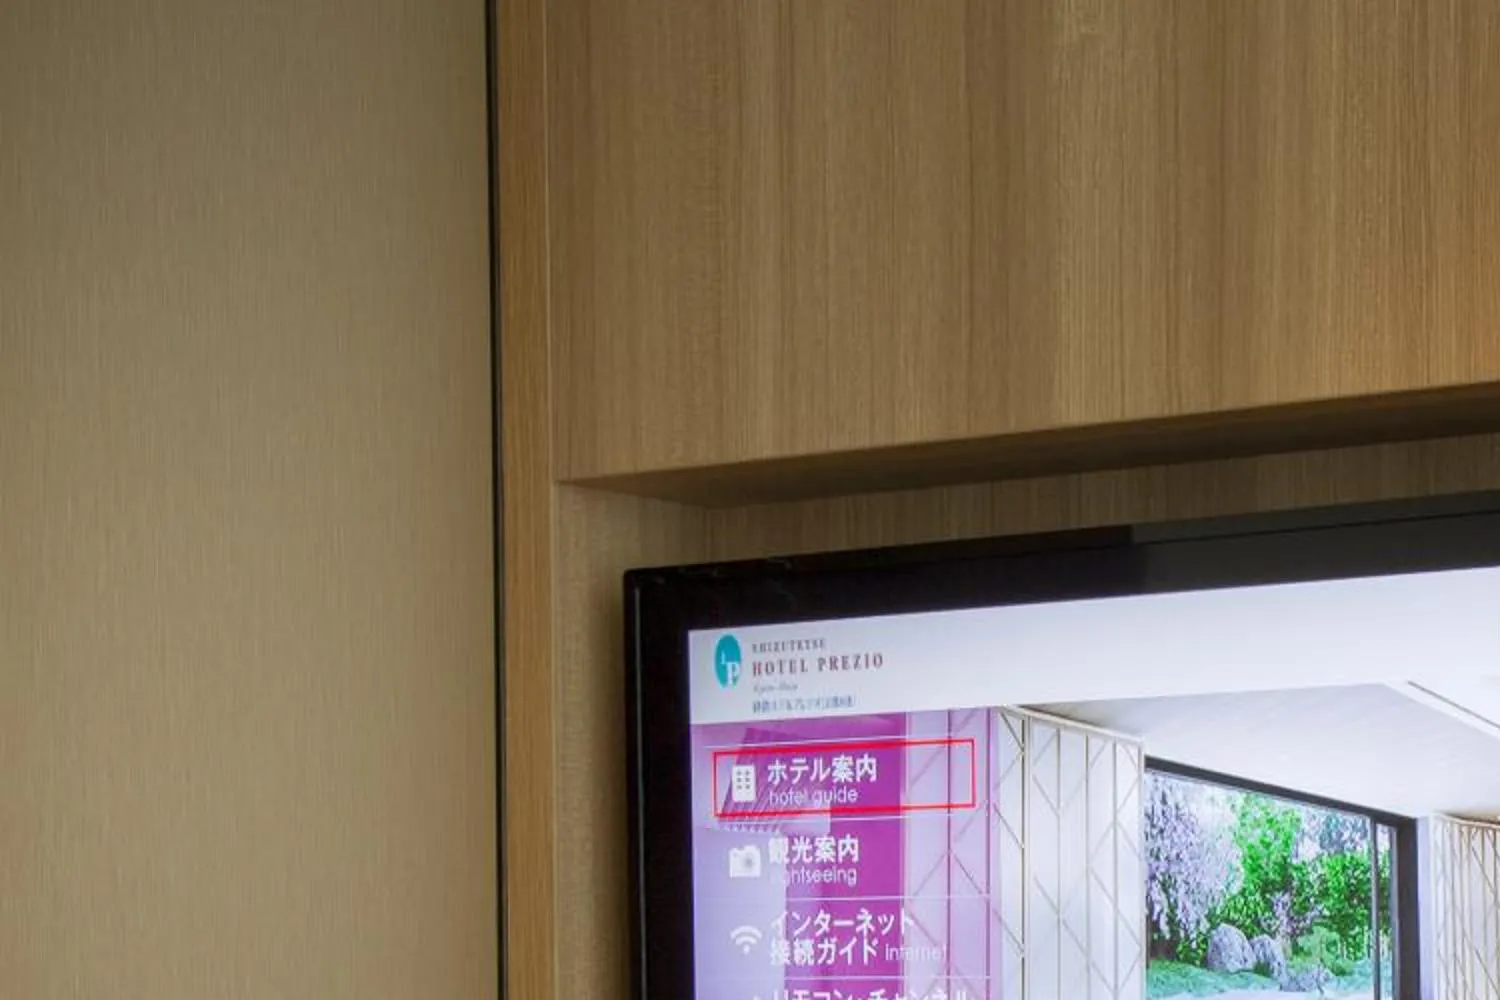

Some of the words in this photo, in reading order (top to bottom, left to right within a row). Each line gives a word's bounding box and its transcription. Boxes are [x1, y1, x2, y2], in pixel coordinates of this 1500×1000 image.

[752, 658, 809, 677] HOTEL
[817, 652, 884, 673] PREZIO
[767, 753, 877, 784] ホテル案内
[771, 907, 914, 938] インターネット
[770, 937, 879, 967] 接続ガイド
